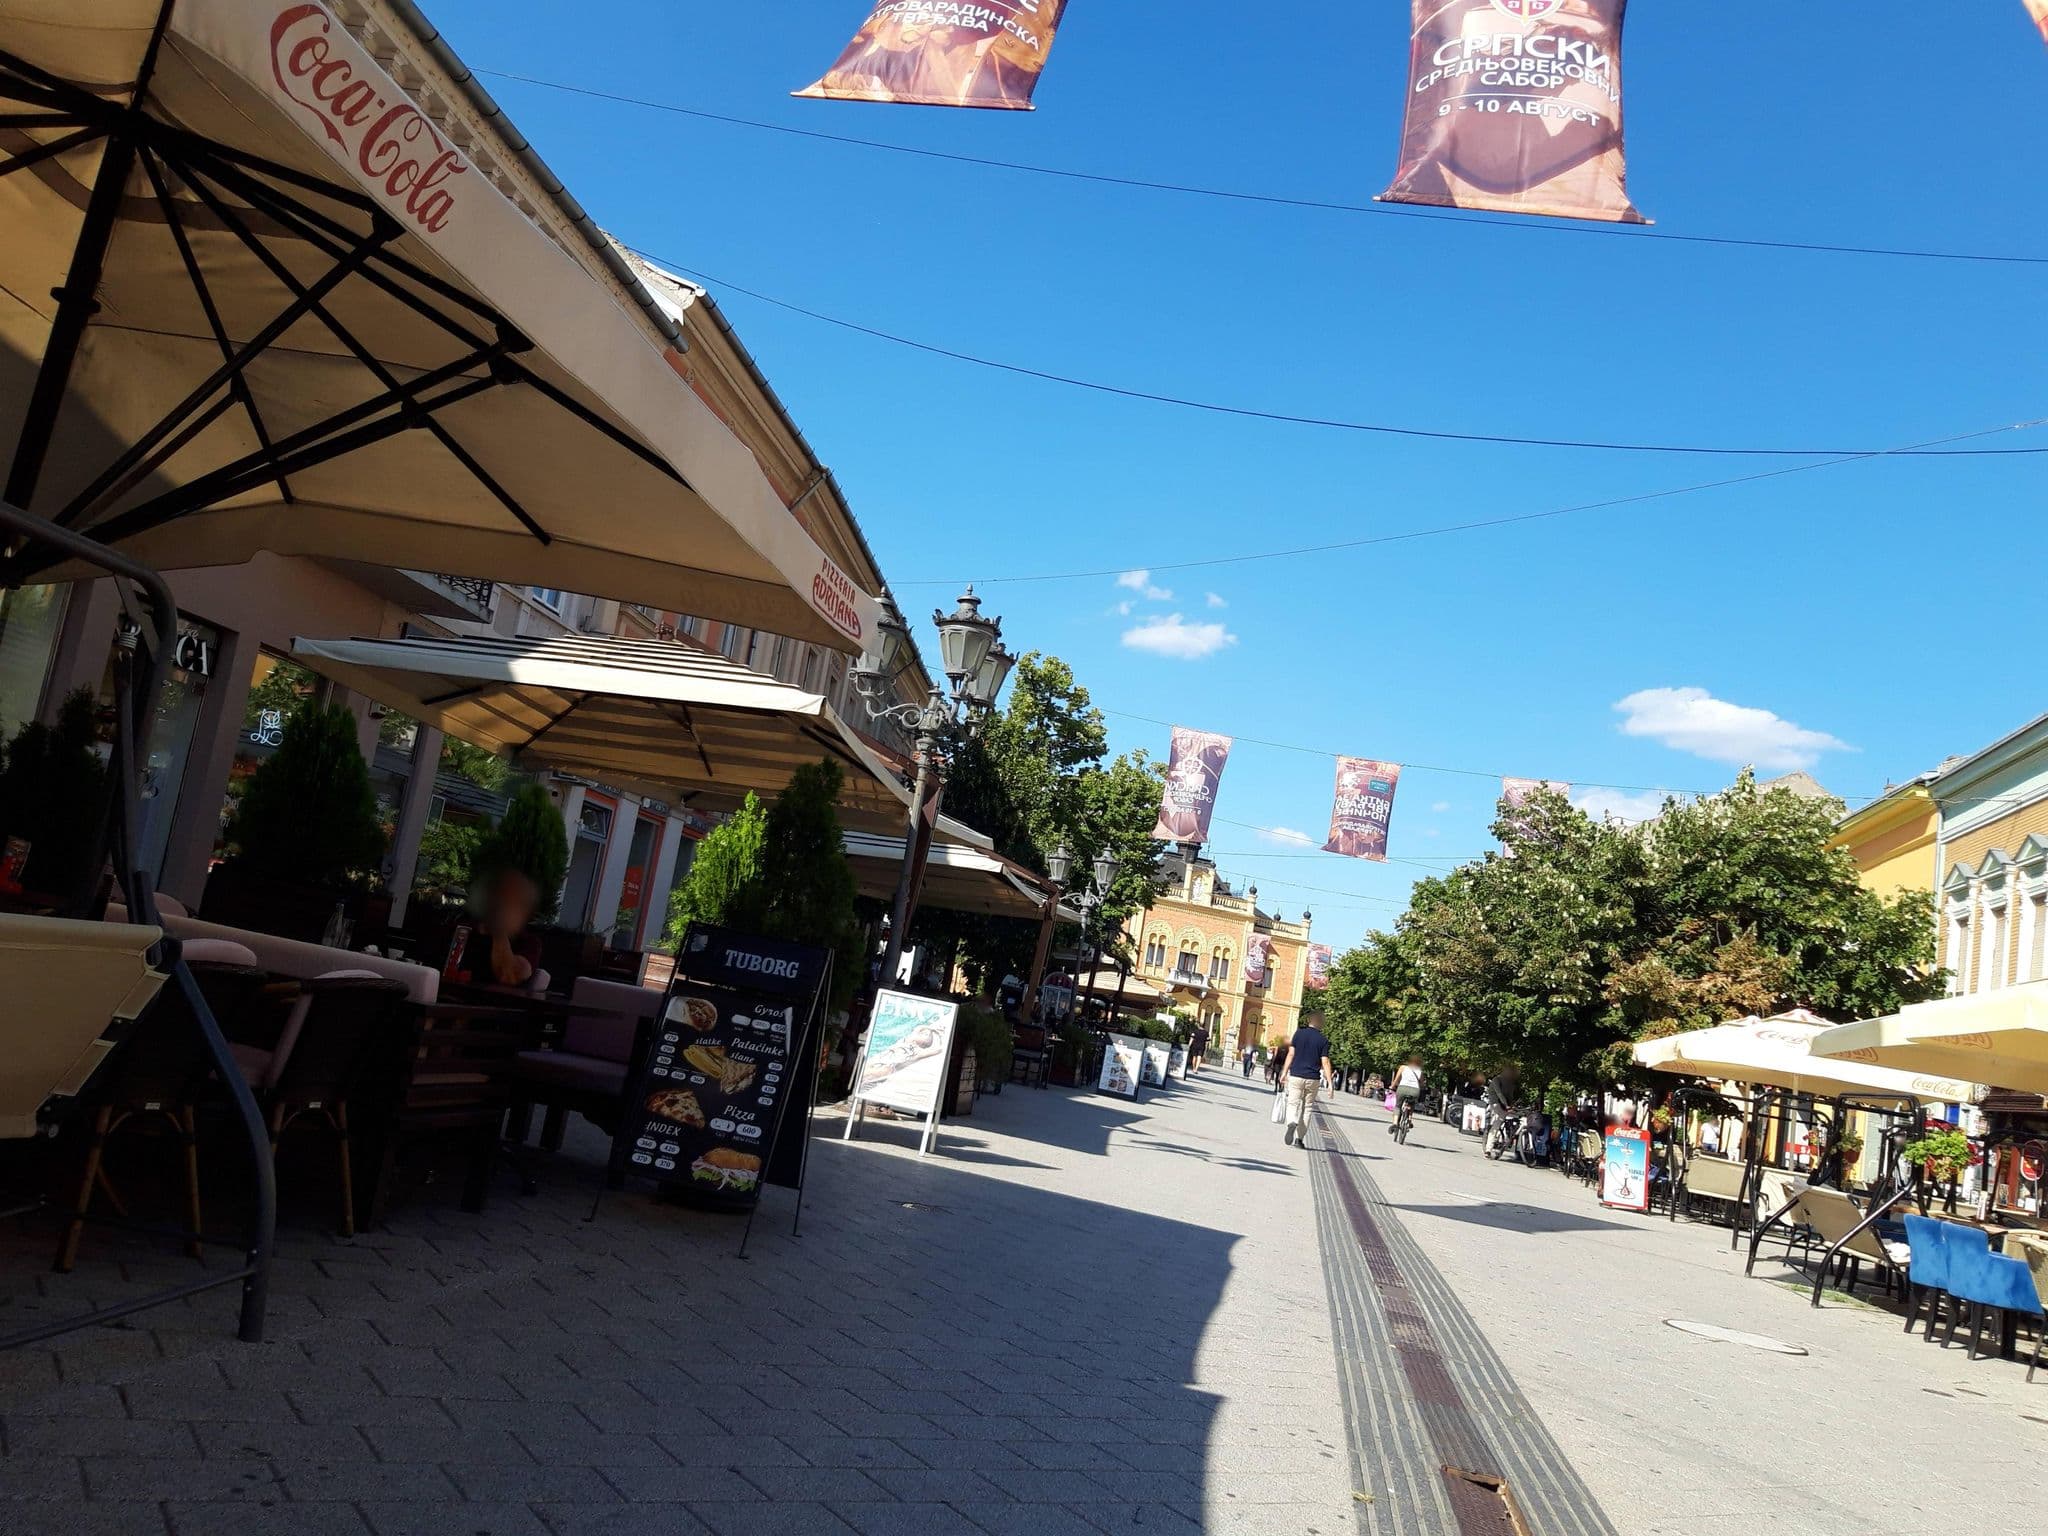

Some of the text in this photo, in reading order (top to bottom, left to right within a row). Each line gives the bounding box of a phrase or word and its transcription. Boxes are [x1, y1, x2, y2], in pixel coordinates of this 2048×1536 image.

[1432, 31, 1611, 78] СРПСКИ
[1415, 56, 1620, 105] СРЕДЊОВЕКОВНИ
[1480, 71, 1565, 90] САБОР
[1438, 104, 1451, 117] 9
[1474, 99, 1500, 113] 10
[1506, 100, 1600, 127] АВГУСТ
[821, 556, 856, 606] PIZZERIA
[813, 572, 860, 630] ADRIJANA
[725, 949, 800, 979] TUBORG
[723, 1104, 756, 1121] Pizza
[646, 1121, 682, 1137] INDEX
